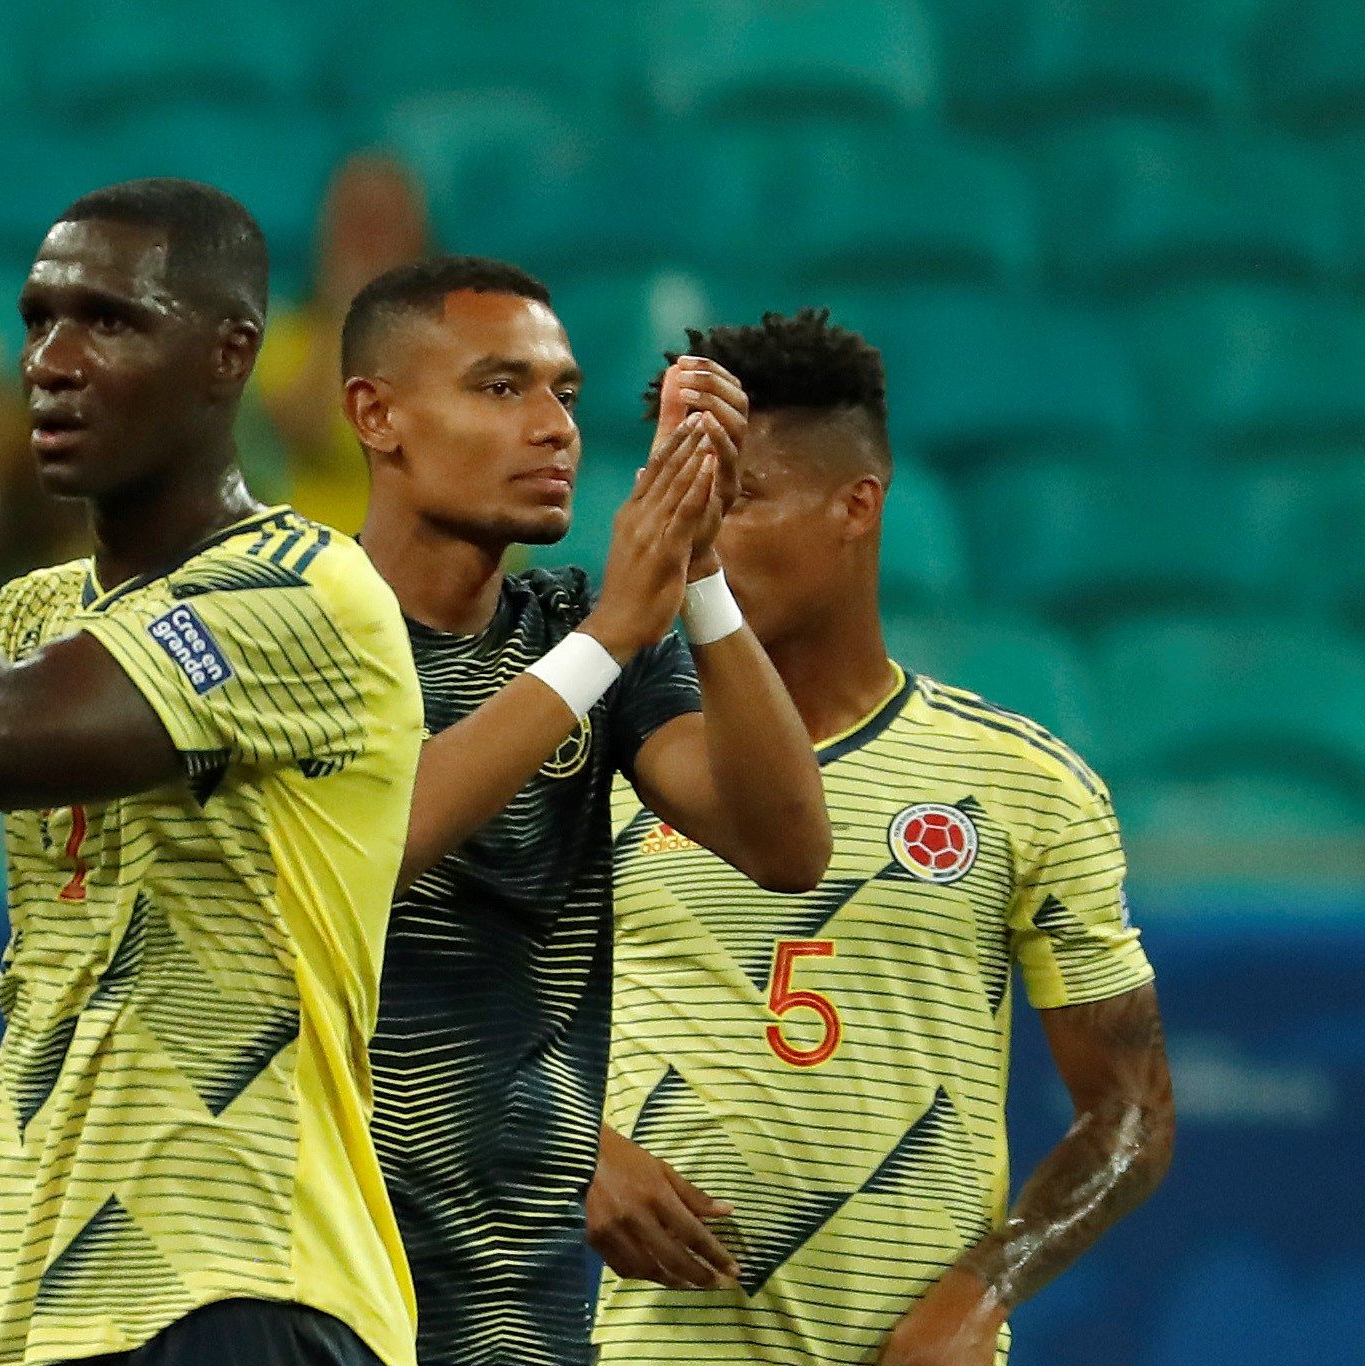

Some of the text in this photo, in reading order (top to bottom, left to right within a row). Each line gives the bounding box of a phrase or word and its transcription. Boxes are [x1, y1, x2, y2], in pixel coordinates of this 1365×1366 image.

[152, 620, 207, 686] grande
[172, 609, 223, 681] Cree en
[766, 939, 842, 1068] 5
